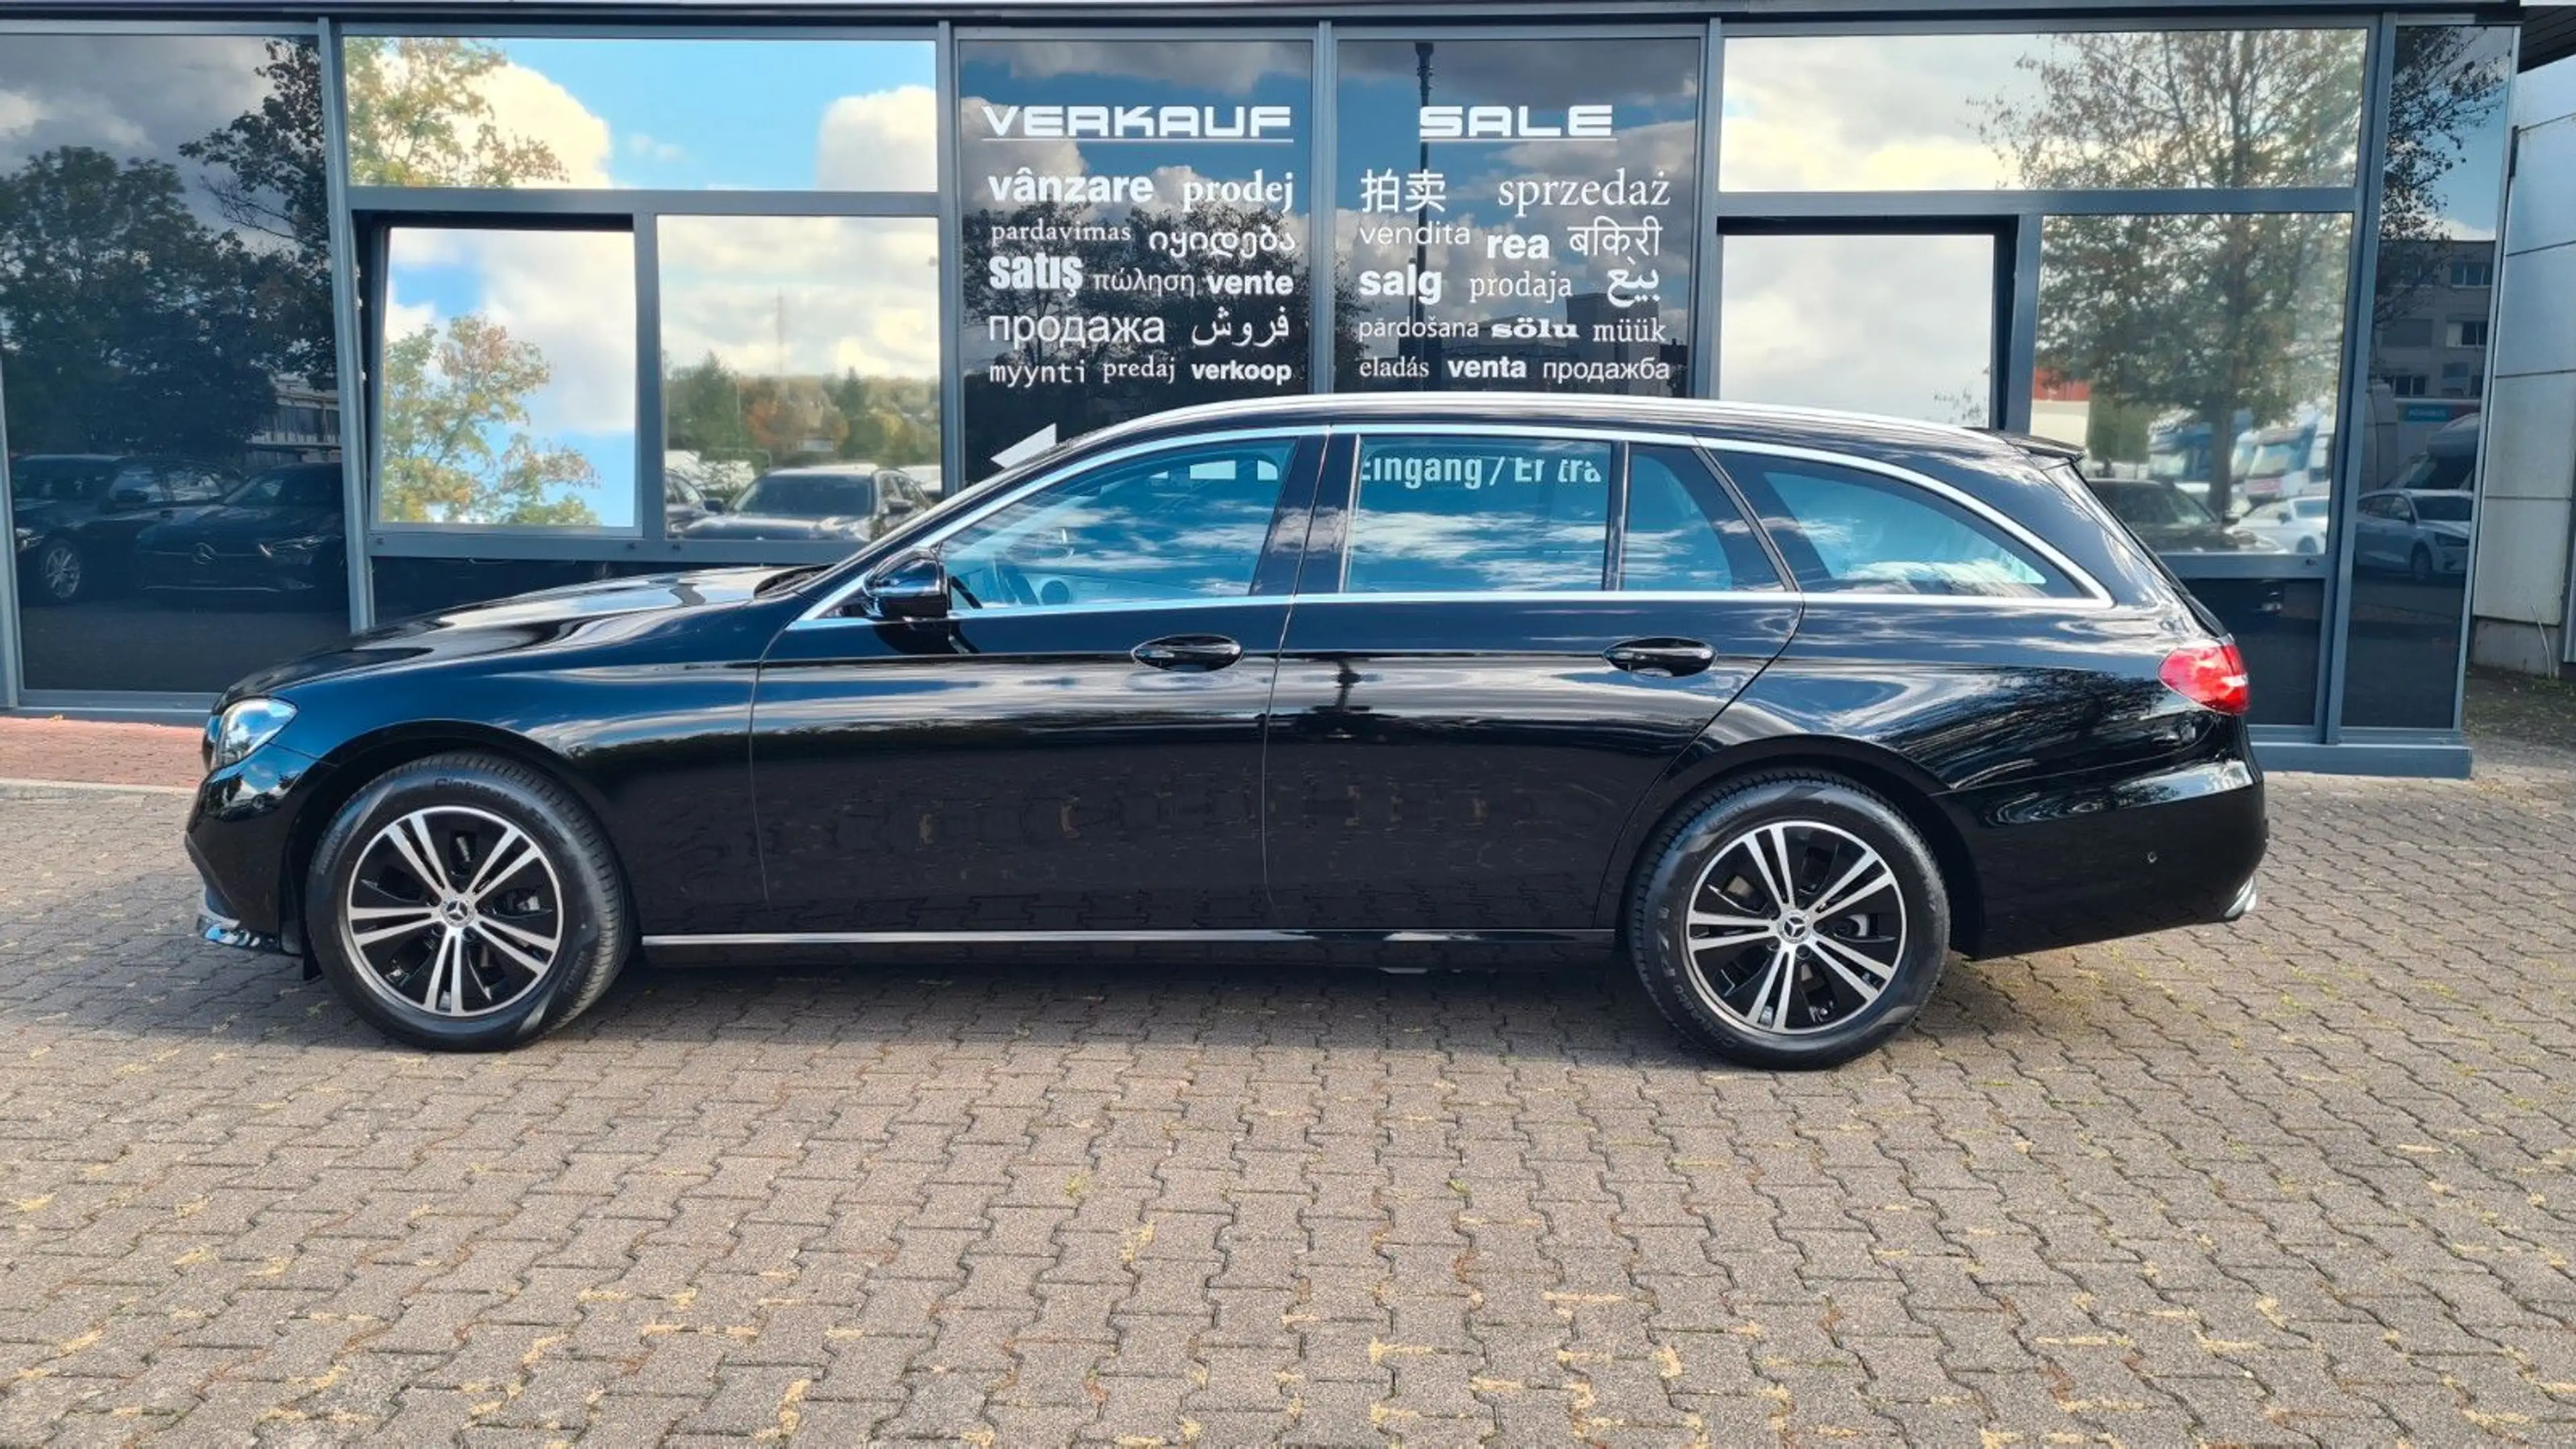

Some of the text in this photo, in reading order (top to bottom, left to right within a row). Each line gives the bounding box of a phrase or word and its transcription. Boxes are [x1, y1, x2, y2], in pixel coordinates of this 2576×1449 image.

[981, 105, 1291, 138] VERKAUF
[1419, 105, 1613, 138] SALE
[988, 166, 1293, 213] vânzare prodej
[1360, 167, 1446, 213] 拍卖
[1498, 168, 1671, 218] sprzedaż
[991, 218, 1131, 248] pardavimas
[1149, 225, 1295, 258] იყიდება
[1360, 221, 1550, 260] vendita rea
[989, 252, 1084, 298] satış
[1093, 268, 1195, 299] πώληση
[1206, 270, 1294, 295] vente
[1360, 263, 1573, 305] salg prodaja
[1607, 268, 1661, 308] بيع
[989, 314, 1166, 350] продажа
[1191, 305, 1289, 347] فروش
[1358, 315, 1668, 343] pārdošana sölu müük
[989, 356, 1292, 388] myynti predaj verkoop
[1360, 356, 1527, 378] eladás venta
[1544, 356, 1670, 384] продажба
